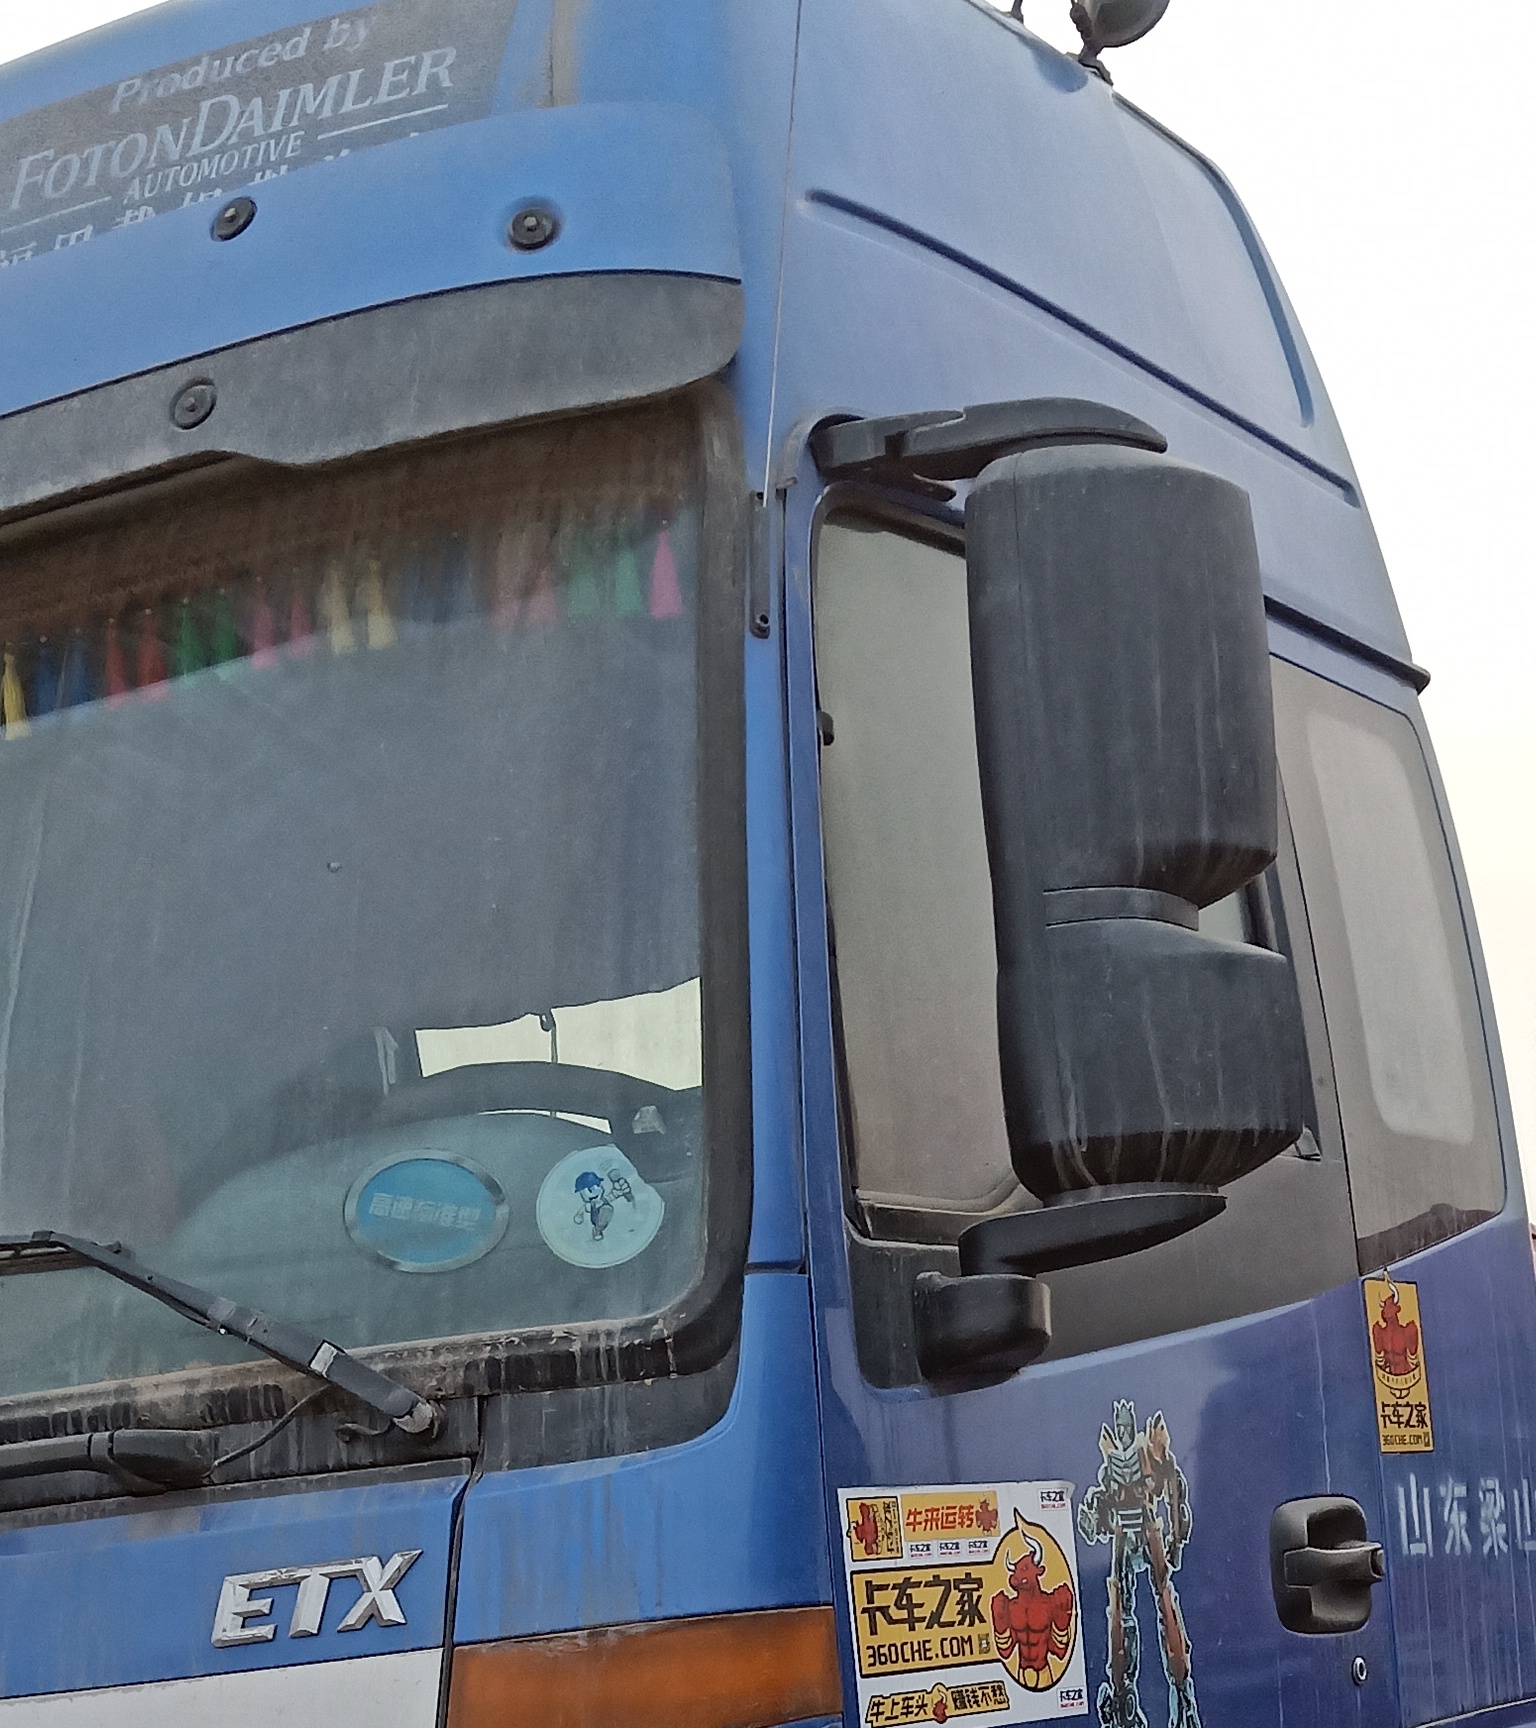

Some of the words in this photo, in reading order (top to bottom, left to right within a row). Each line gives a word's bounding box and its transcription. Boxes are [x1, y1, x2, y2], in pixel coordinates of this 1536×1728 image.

[111, 26, 312, 114] Produced
[321, 12, 374, 58] by
[123, 130, 305, 206] AUTOMOTIVE
[1379, 1401, 1429, 1429] 卡车之家
[904, 1504, 975, 1533] 牛来运转
[210, 1549, 424, 1649] ETX
[860, 1571, 988, 1637] 卡车之家
[865, 1634, 975, 1669] 360CHE.COM
[868, 1694, 930, 1724] 牛上车头
